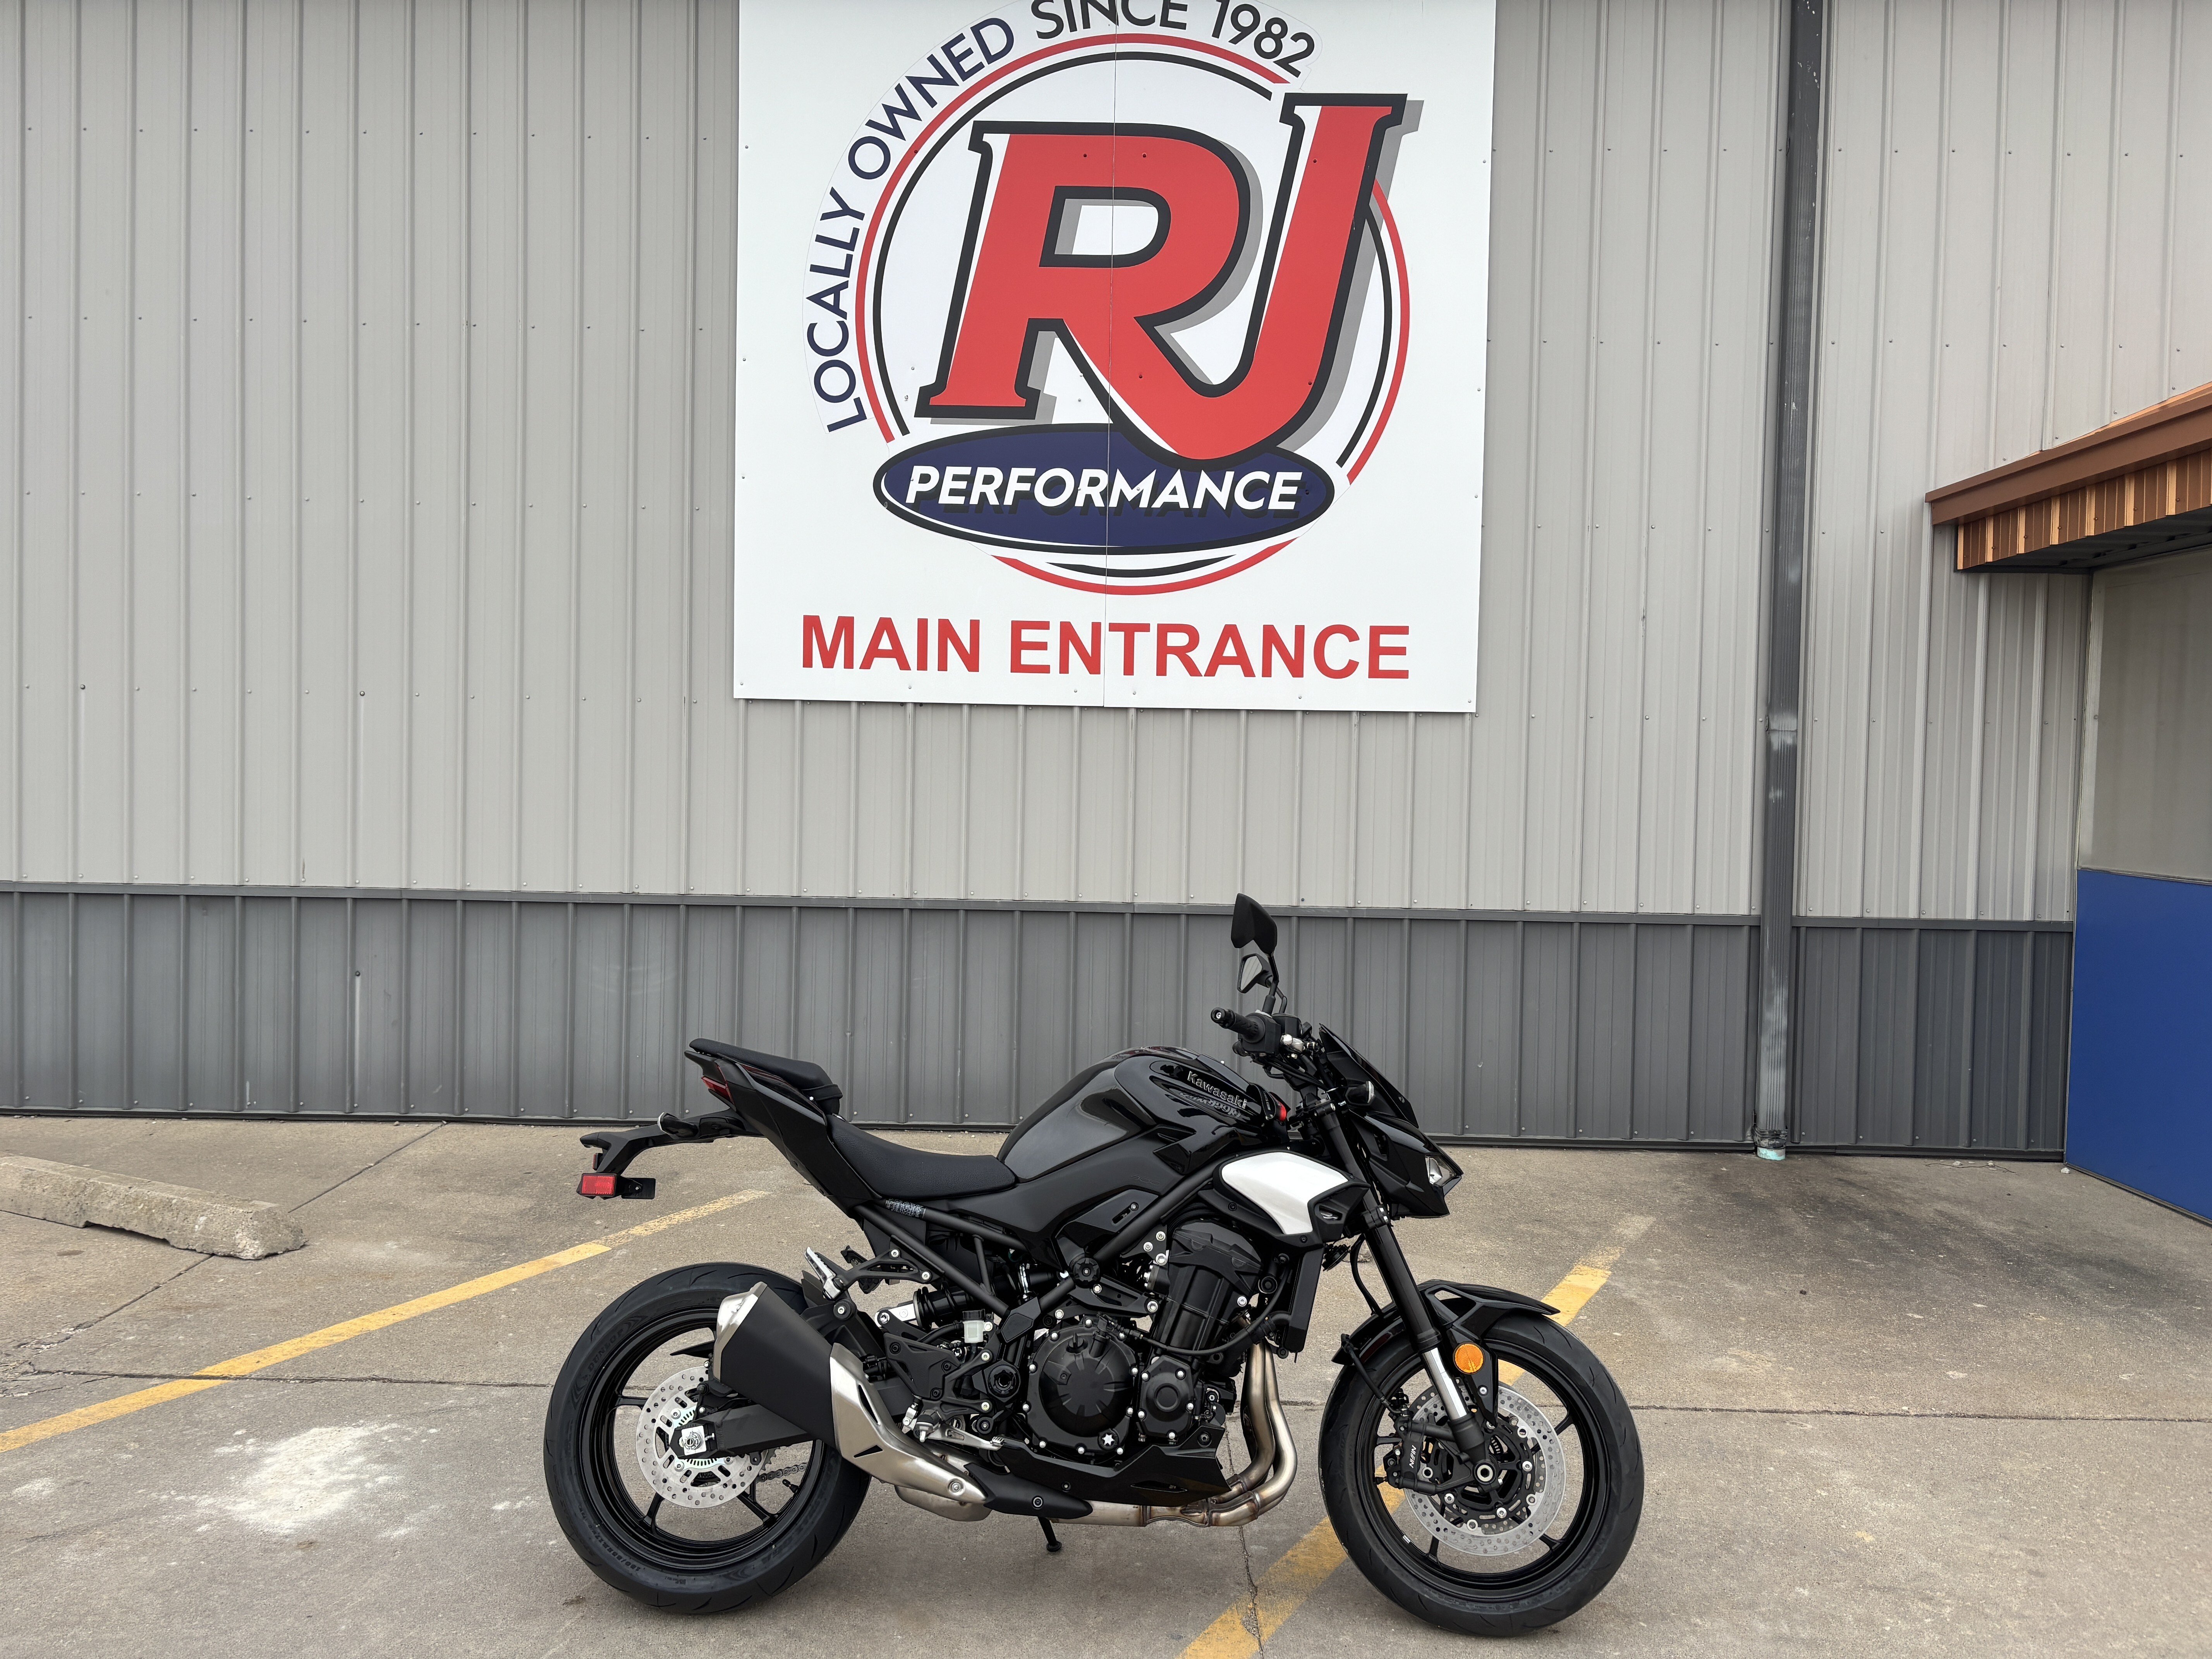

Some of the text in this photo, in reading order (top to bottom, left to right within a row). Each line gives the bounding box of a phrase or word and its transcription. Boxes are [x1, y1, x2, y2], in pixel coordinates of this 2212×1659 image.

[805, 0, 1315, 433] LOCALLY OWNED SINCE 1982
[914, 93, 1408, 468] RJ
[905, 465, 1302, 510] PERFORMANCE
[803, 615, 1409, 679] MAIN ENTRANCE
[1187, 1070, 1247, 1109] Kawasaki
[588, 1328, 624, 1374] DUNLOP
